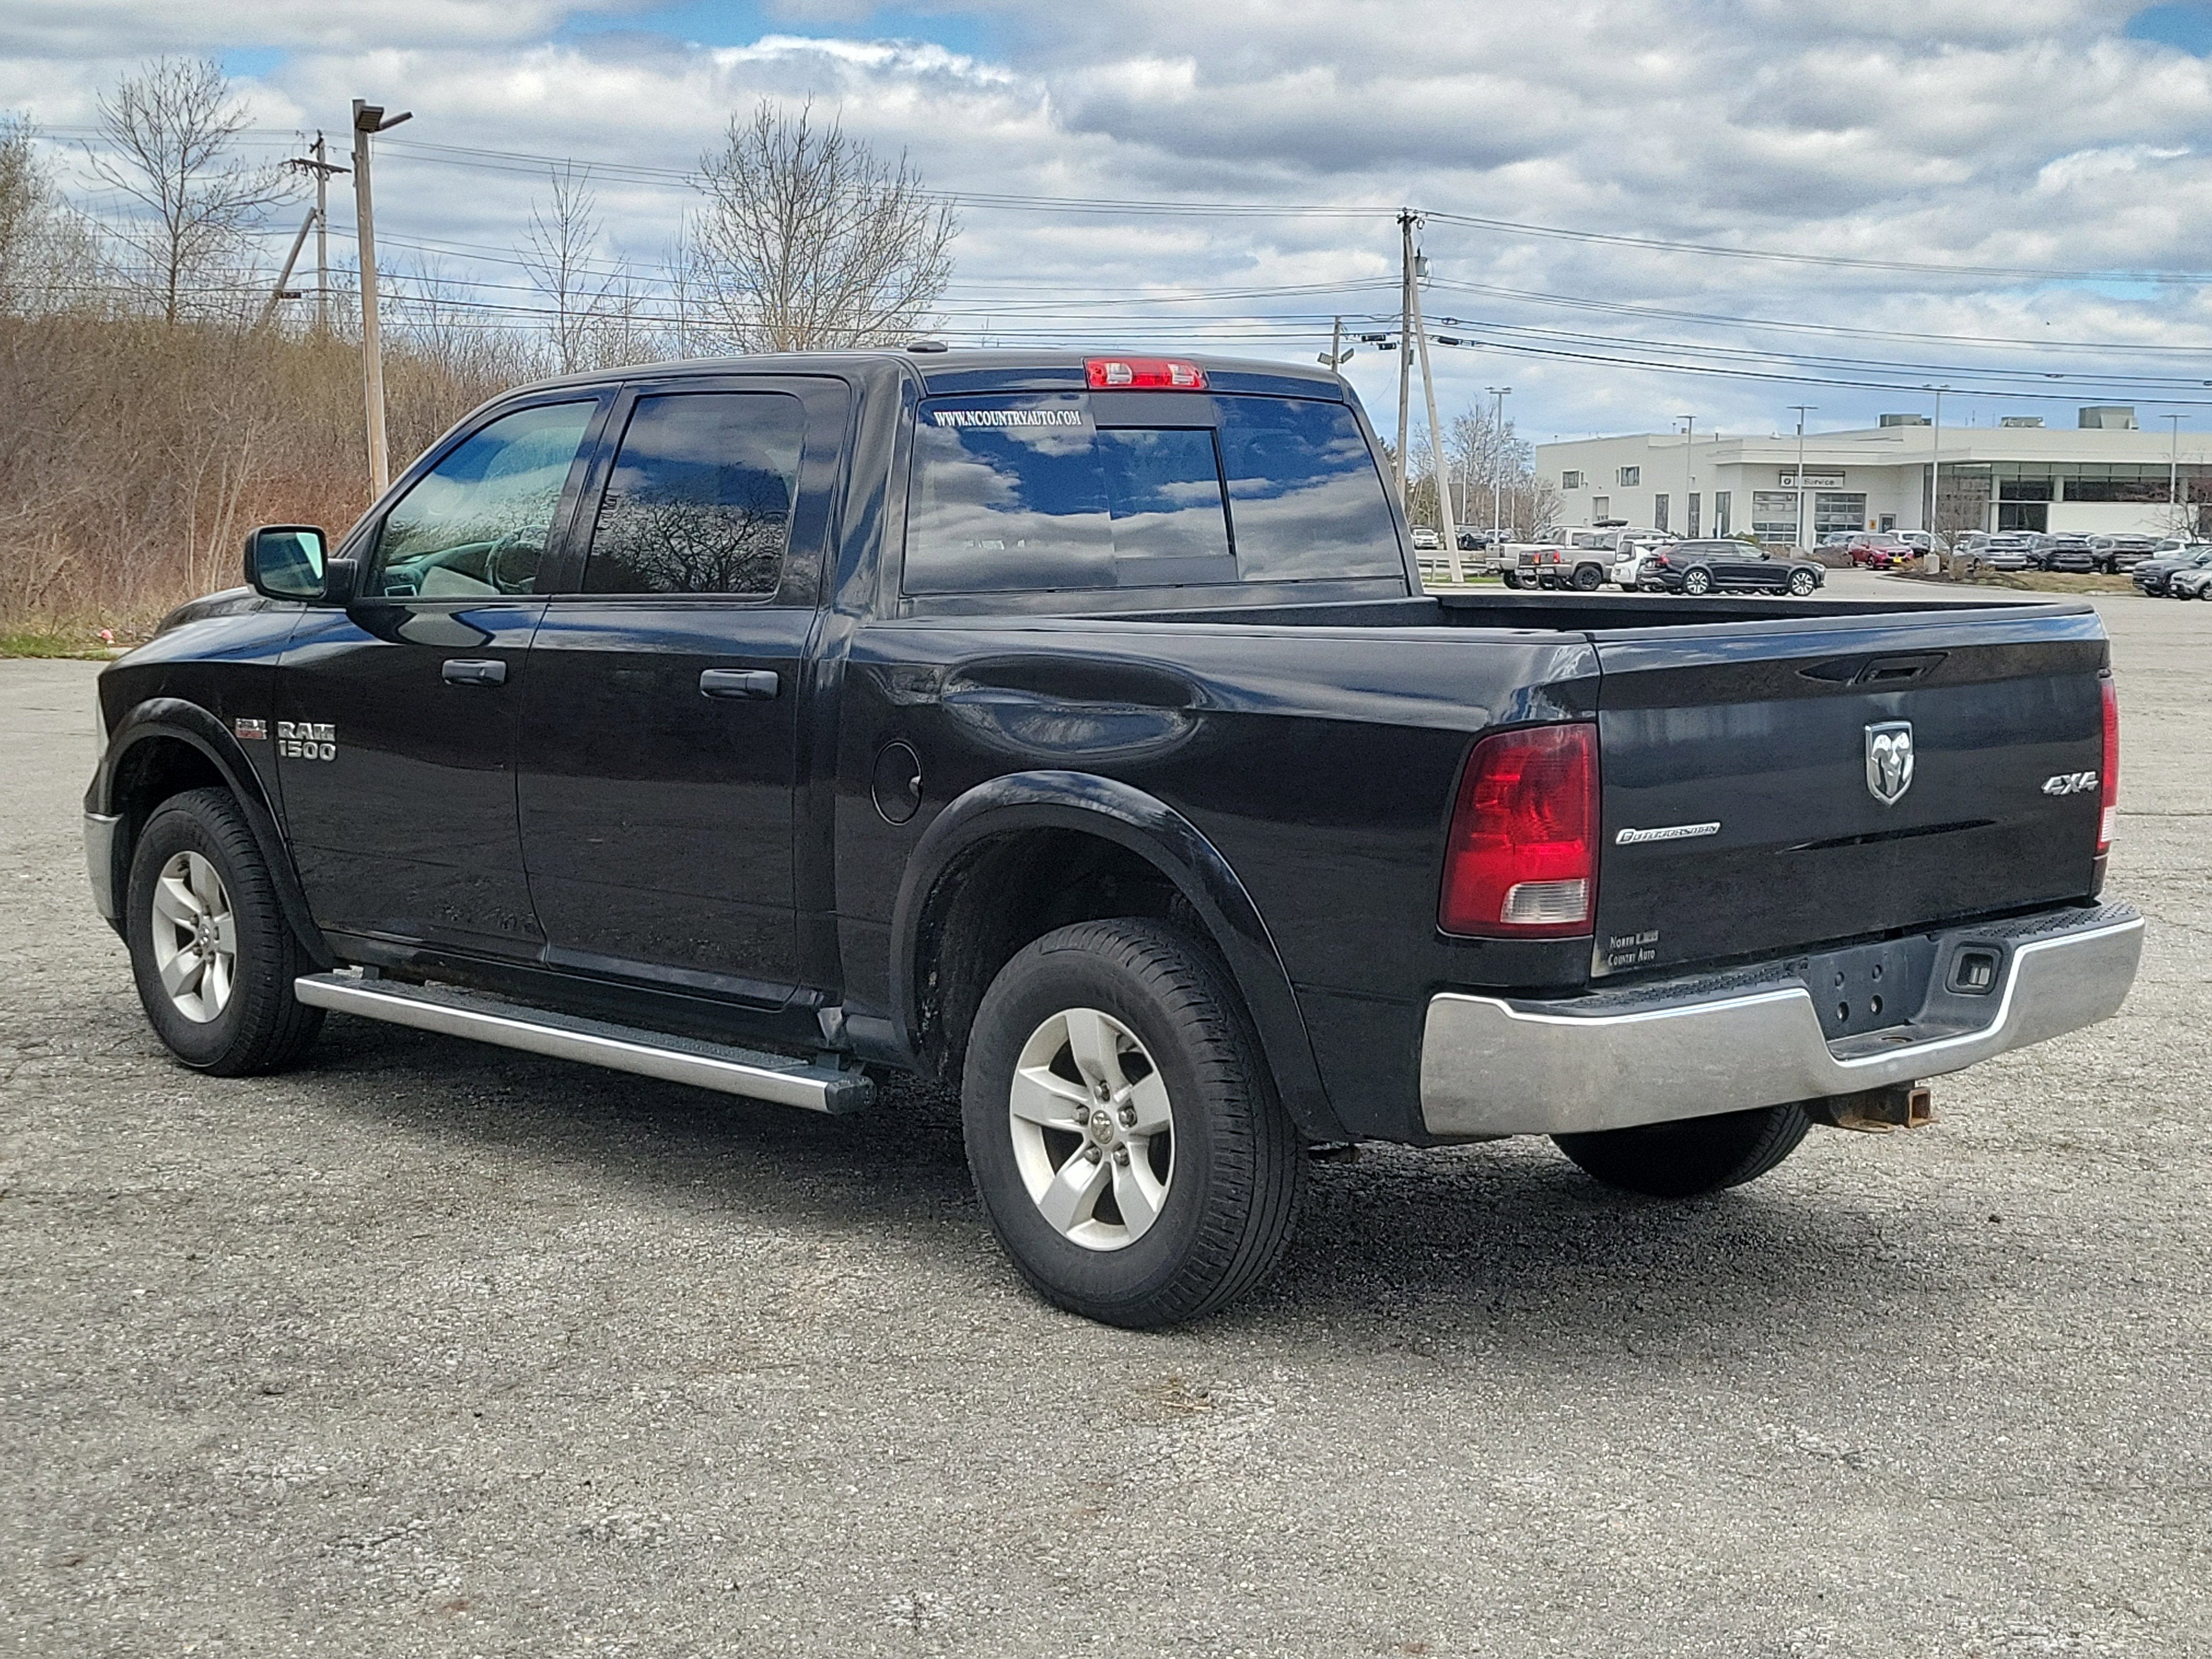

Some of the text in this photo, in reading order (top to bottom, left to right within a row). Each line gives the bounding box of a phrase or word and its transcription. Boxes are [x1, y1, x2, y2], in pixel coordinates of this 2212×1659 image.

[933, 410, 1082, 427] WWW.NCOUNTRYAUTO.COM
[278, 721, 336, 741] RAM
[279, 740, 336, 761] 1500
